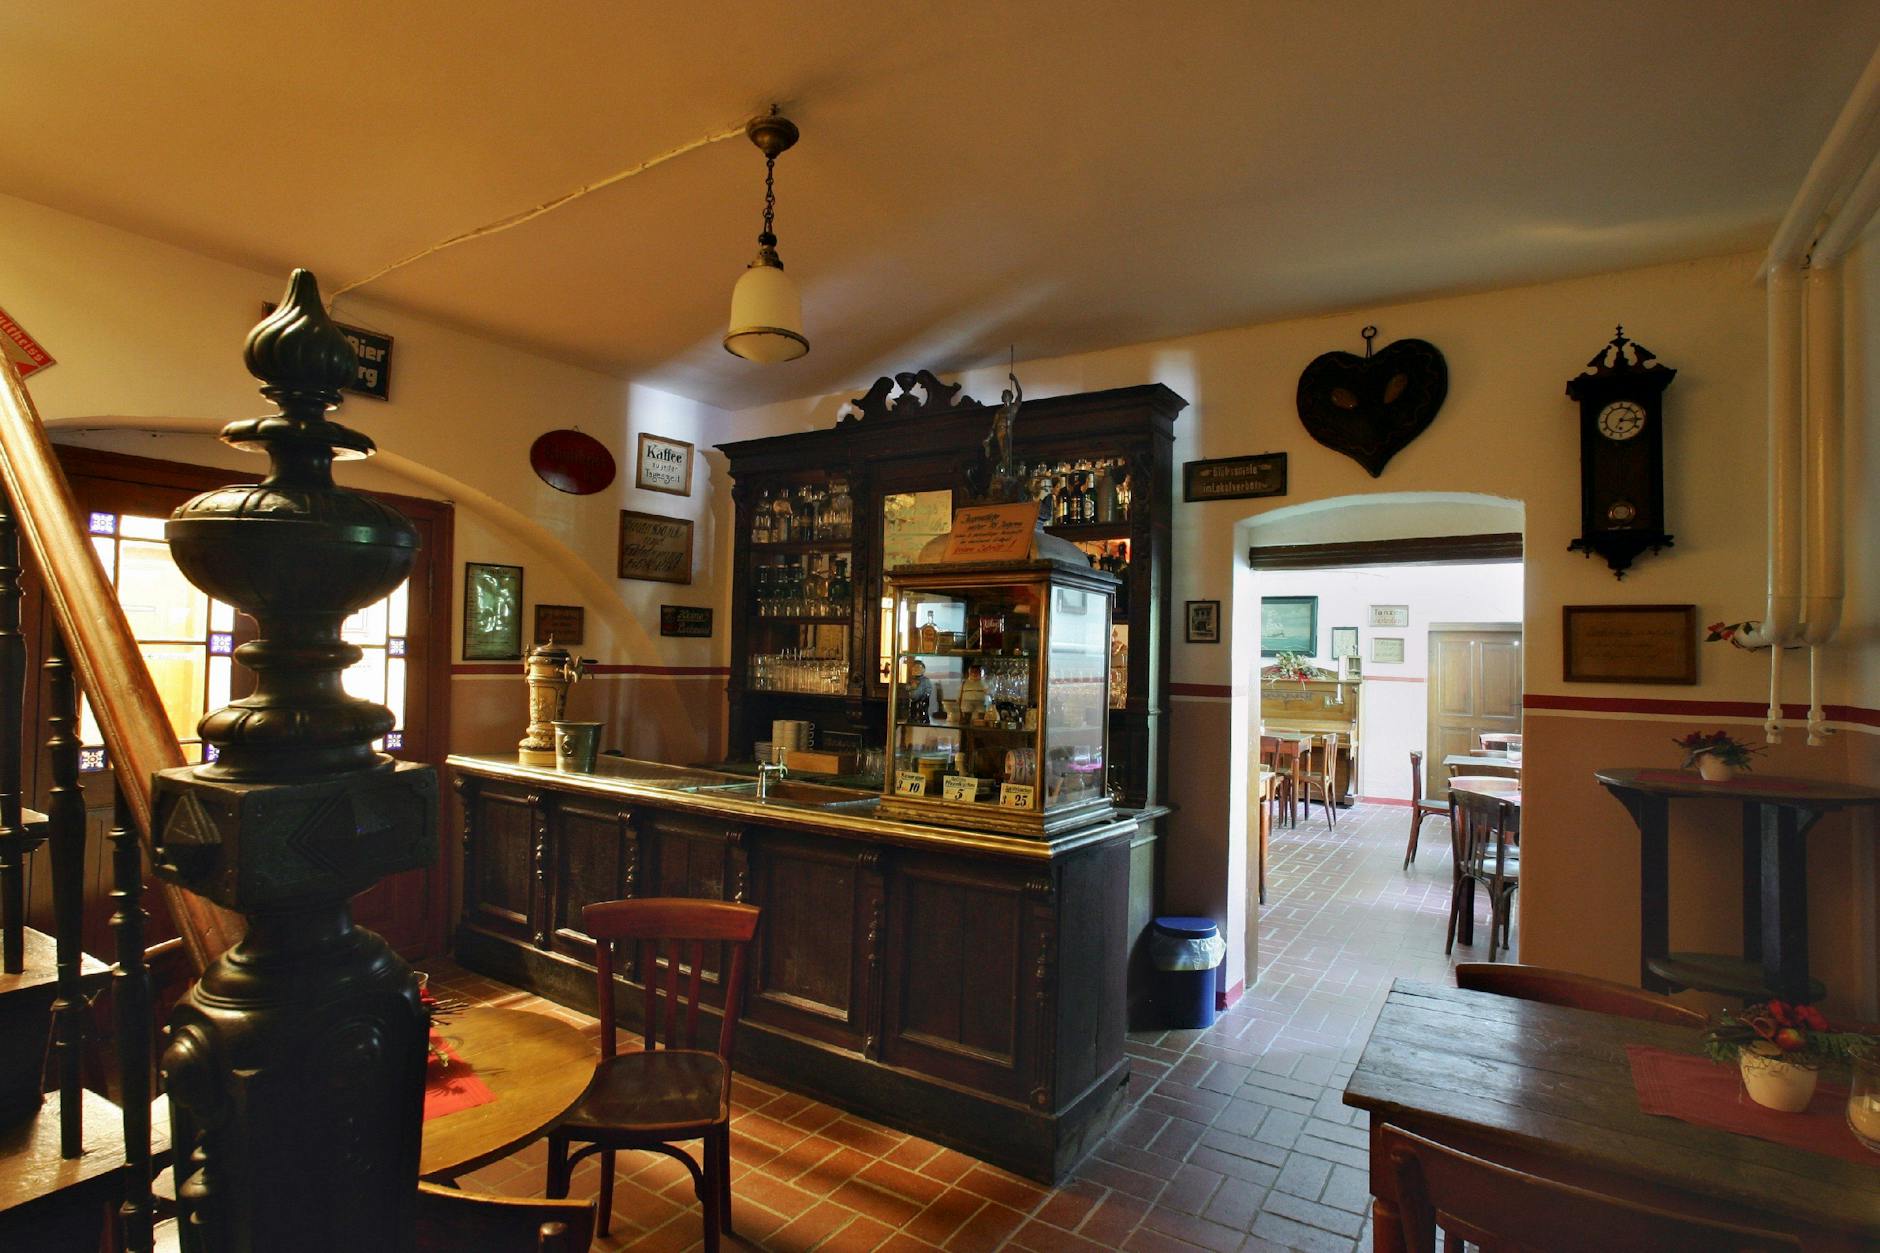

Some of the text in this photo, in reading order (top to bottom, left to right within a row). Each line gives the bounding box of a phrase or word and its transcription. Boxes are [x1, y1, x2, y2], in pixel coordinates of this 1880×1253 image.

[647, 444, 683, 464] Kaffee
[645, 468, 680, 484] Tageszeit
[908, 782, 920, 793] 10
[954, 789, 964, 800] 5
[1014, 794, 1028, 807] 25
